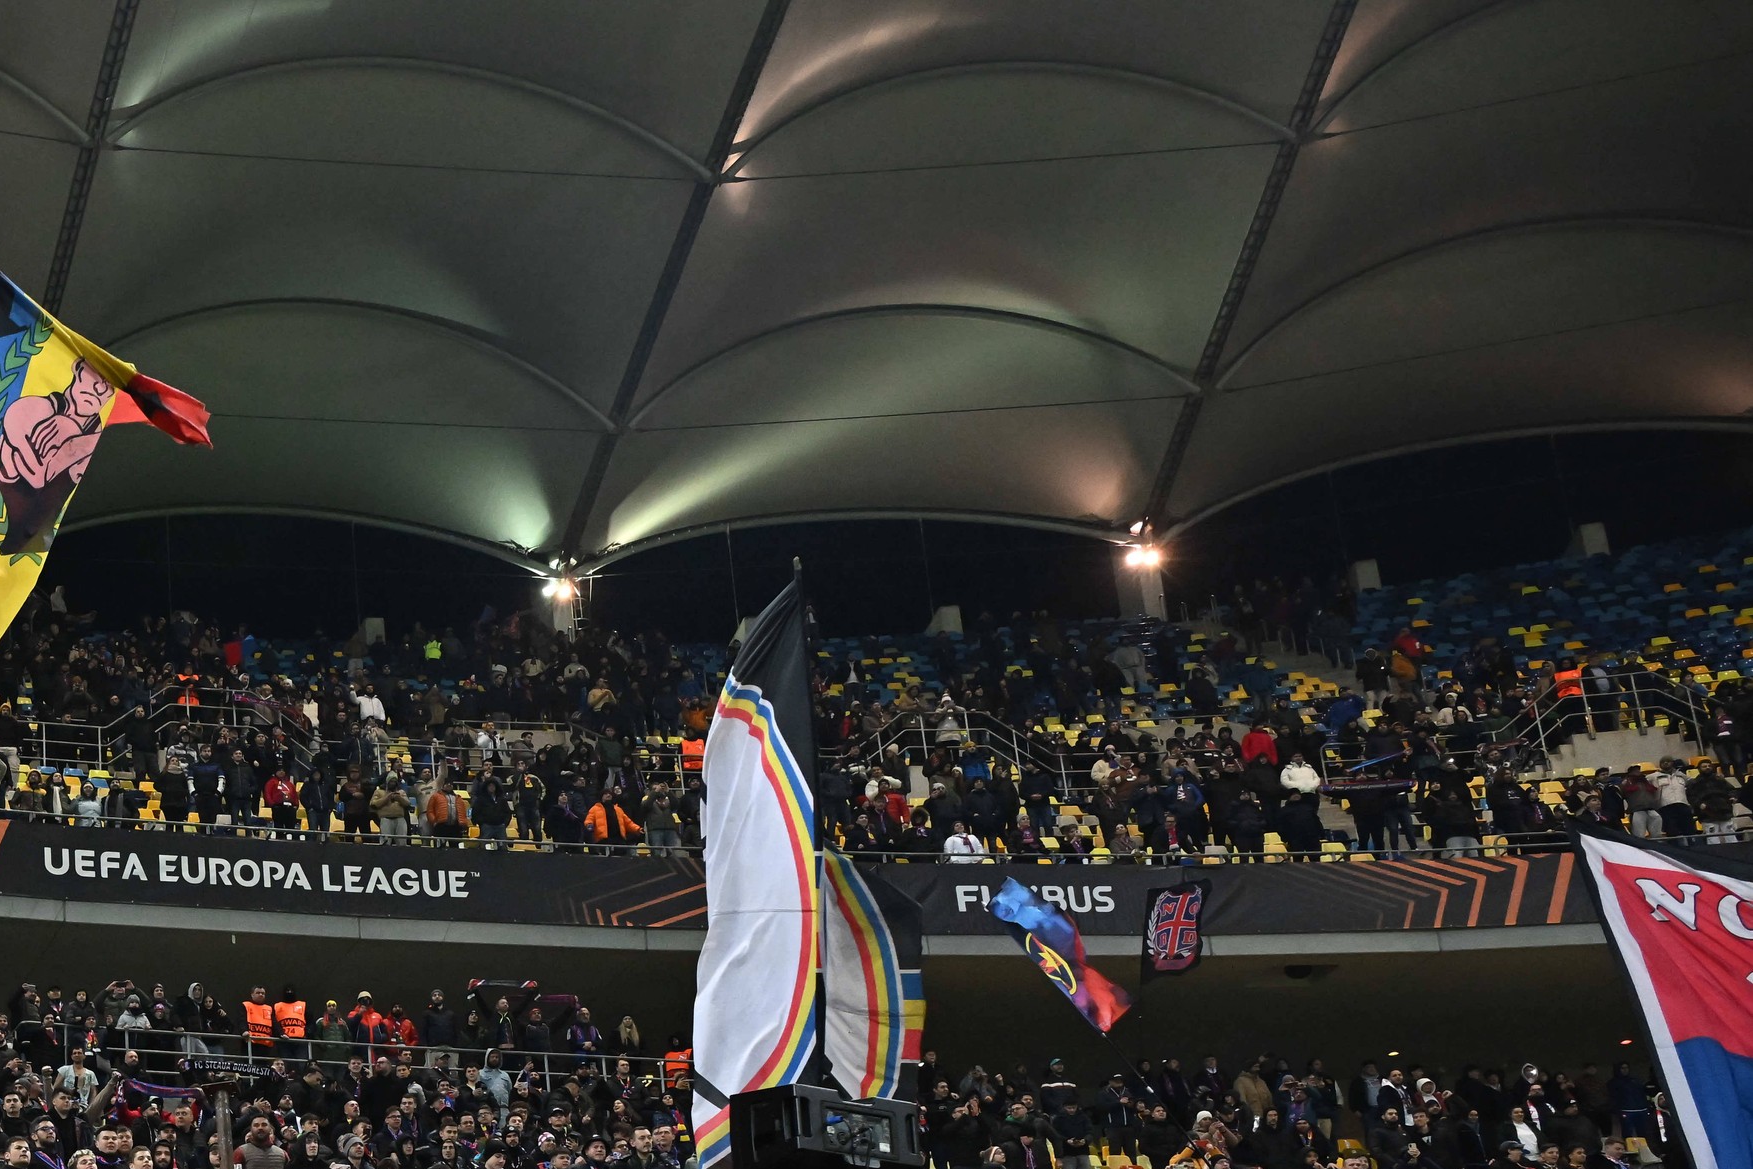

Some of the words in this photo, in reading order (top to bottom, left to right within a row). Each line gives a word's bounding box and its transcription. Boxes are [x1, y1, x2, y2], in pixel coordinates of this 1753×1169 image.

[43, 846, 149, 881] UEFA
[158, 853, 312, 891] EUROPA
[321, 864, 471, 898] LEAGUE
[194, 1061, 203, 1069] FC
[205, 1060, 231, 1071] STEAUA
